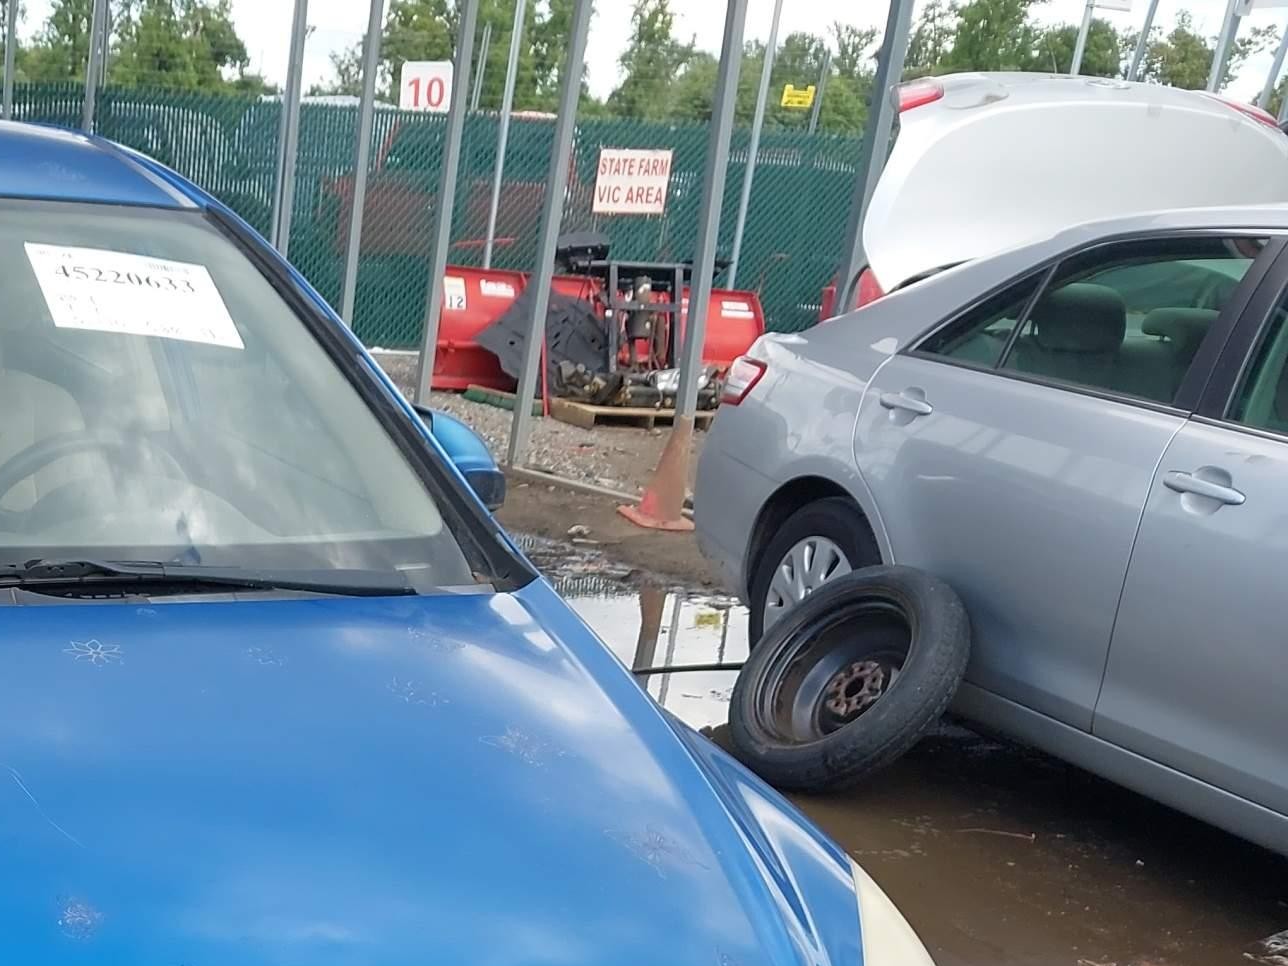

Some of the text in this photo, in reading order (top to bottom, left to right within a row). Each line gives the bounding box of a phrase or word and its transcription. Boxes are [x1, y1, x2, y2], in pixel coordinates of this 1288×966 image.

[408, 77, 444, 107] 10
[600, 157, 669, 177] STATE FARM
[598, 185, 663, 204] VIC AREA
[55, 264, 196, 293] 45220633
